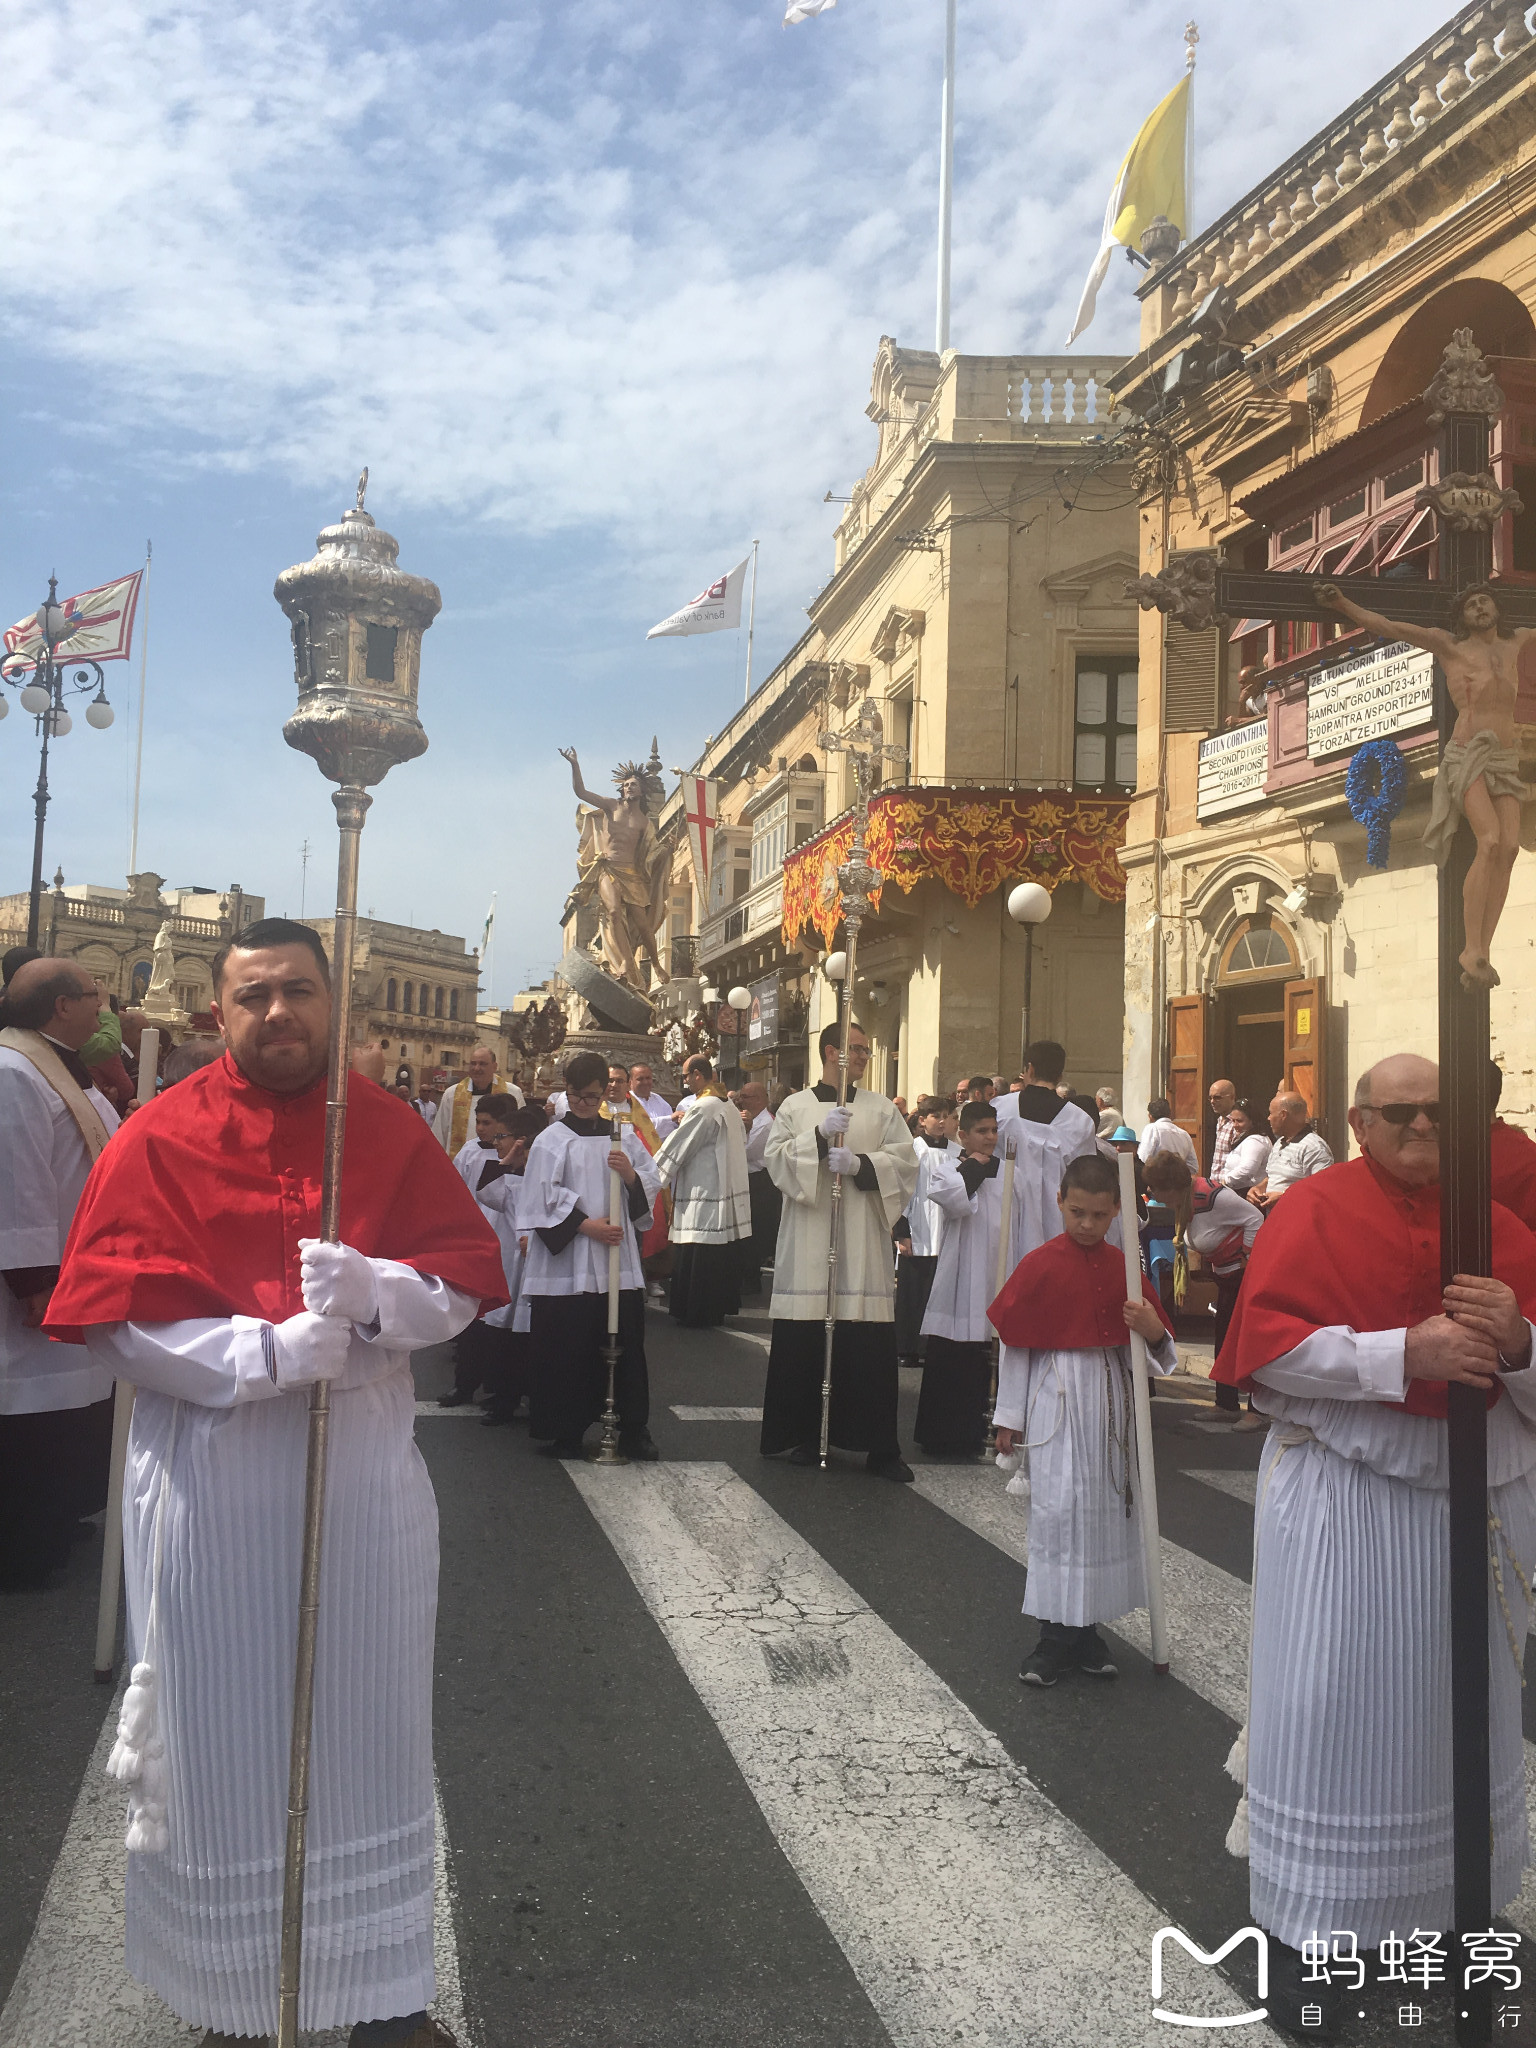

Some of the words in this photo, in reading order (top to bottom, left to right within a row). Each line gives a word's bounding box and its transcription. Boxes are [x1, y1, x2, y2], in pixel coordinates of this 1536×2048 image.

[1451, 491, 1490, 507] INRI
[1311, 666, 1344, 688] ZEJTUN
[1346, 642, 1411, 674] CORINTHIANS
[1324, 686, 1337, 700] VS
[1356, 660, 1408, 688] MELLIEHA
[1308, 701, 1345, 722] HAMRUN
[1350, 683, 1391, 706] GROUND
[1408, 687, 1430, 705] 2PM
[1320, 733, 1350, 751] FORZA
[1357, 716, 1397, 739] ZEJTUN
[1202, 737, 1225, 758] ZEJTUN
[1208, 753, 1237, 770] SECOND
[1218, 758, 1262, 781] CHAMPIONS
[1222, 774, 1259, 793] 2016-2017
